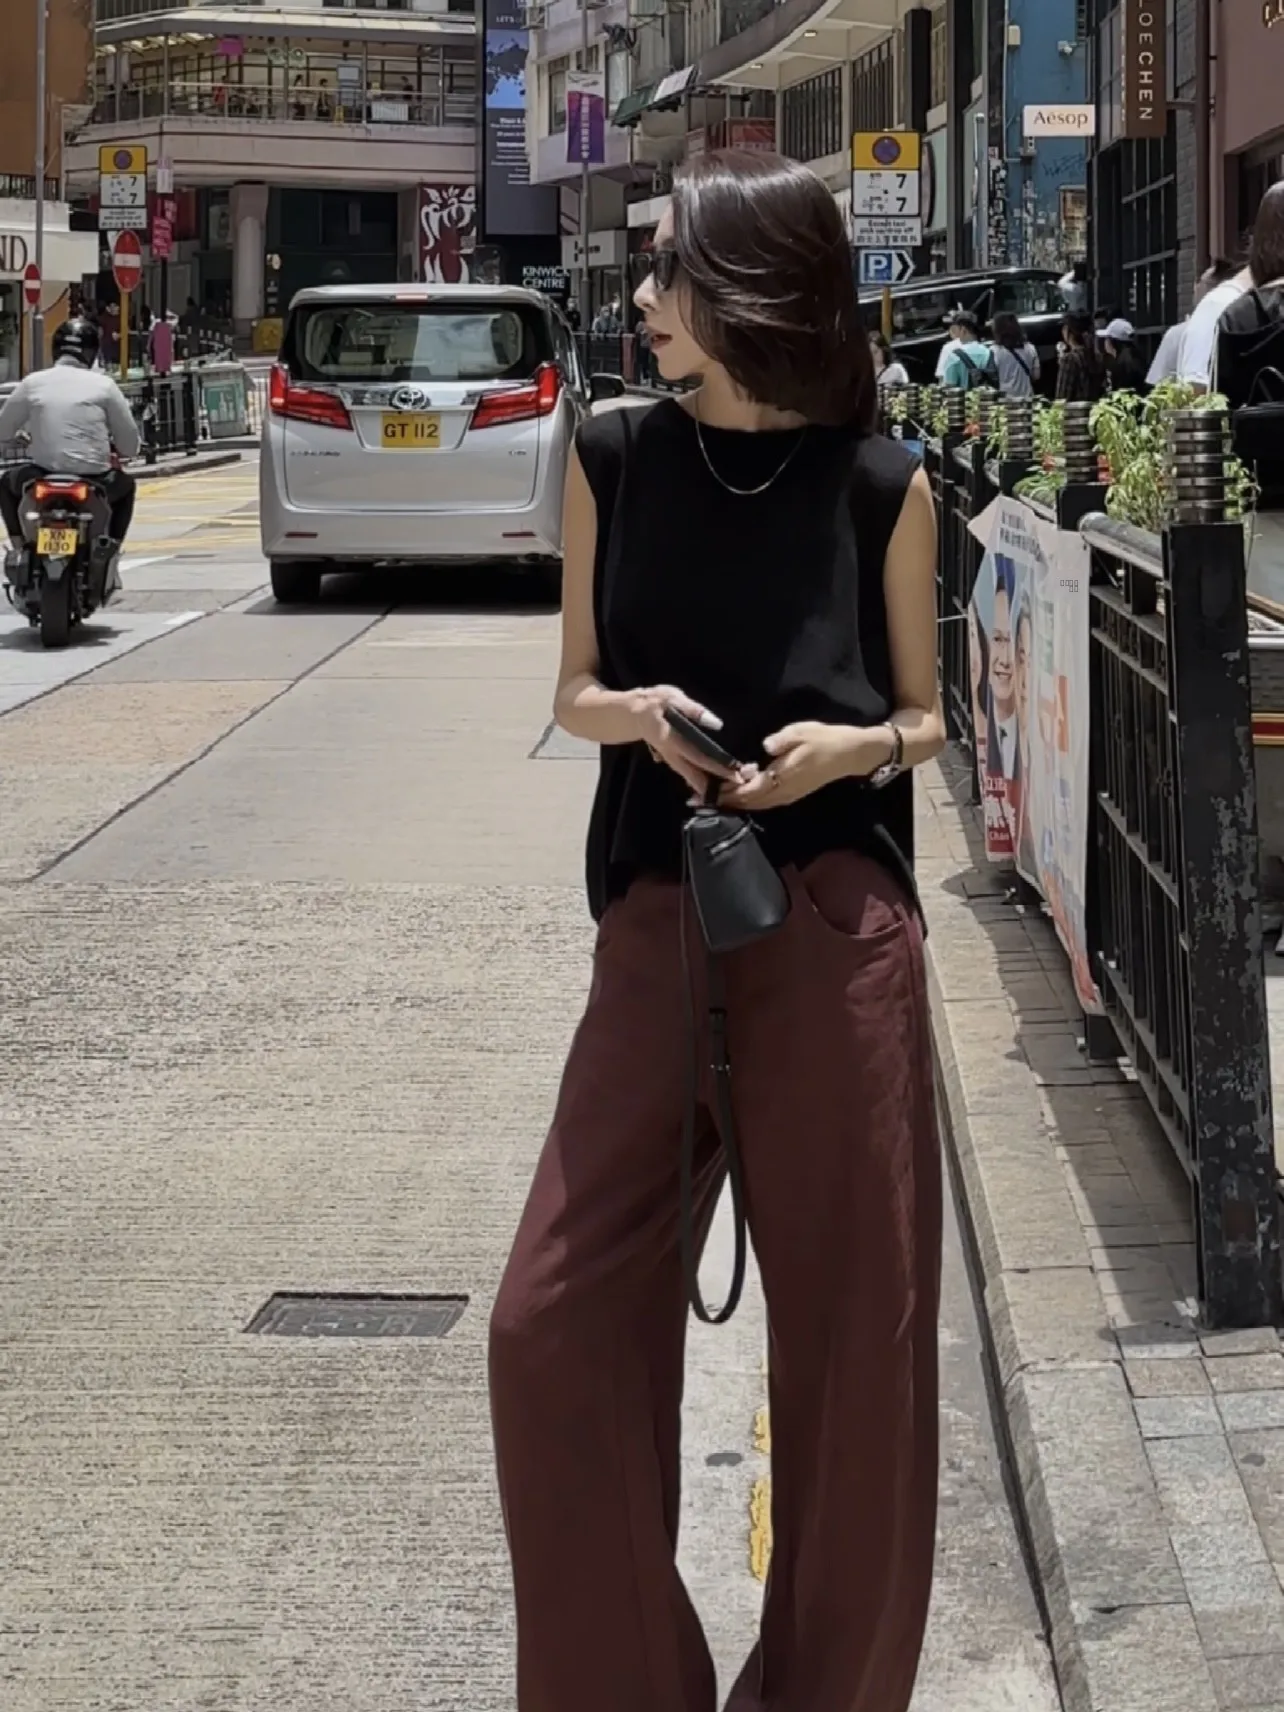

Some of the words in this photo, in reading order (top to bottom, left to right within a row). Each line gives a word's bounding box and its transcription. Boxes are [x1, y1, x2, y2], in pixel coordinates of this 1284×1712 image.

[896, 173, 907, 189] 7
[896, 197, 907, 212] 7
[522, 265, 570, 278] KINWICK
[522, 278, 566, 290] CENTRE
[383, 423, 409, 439] GT
[414, 423, 438, 438] 112
